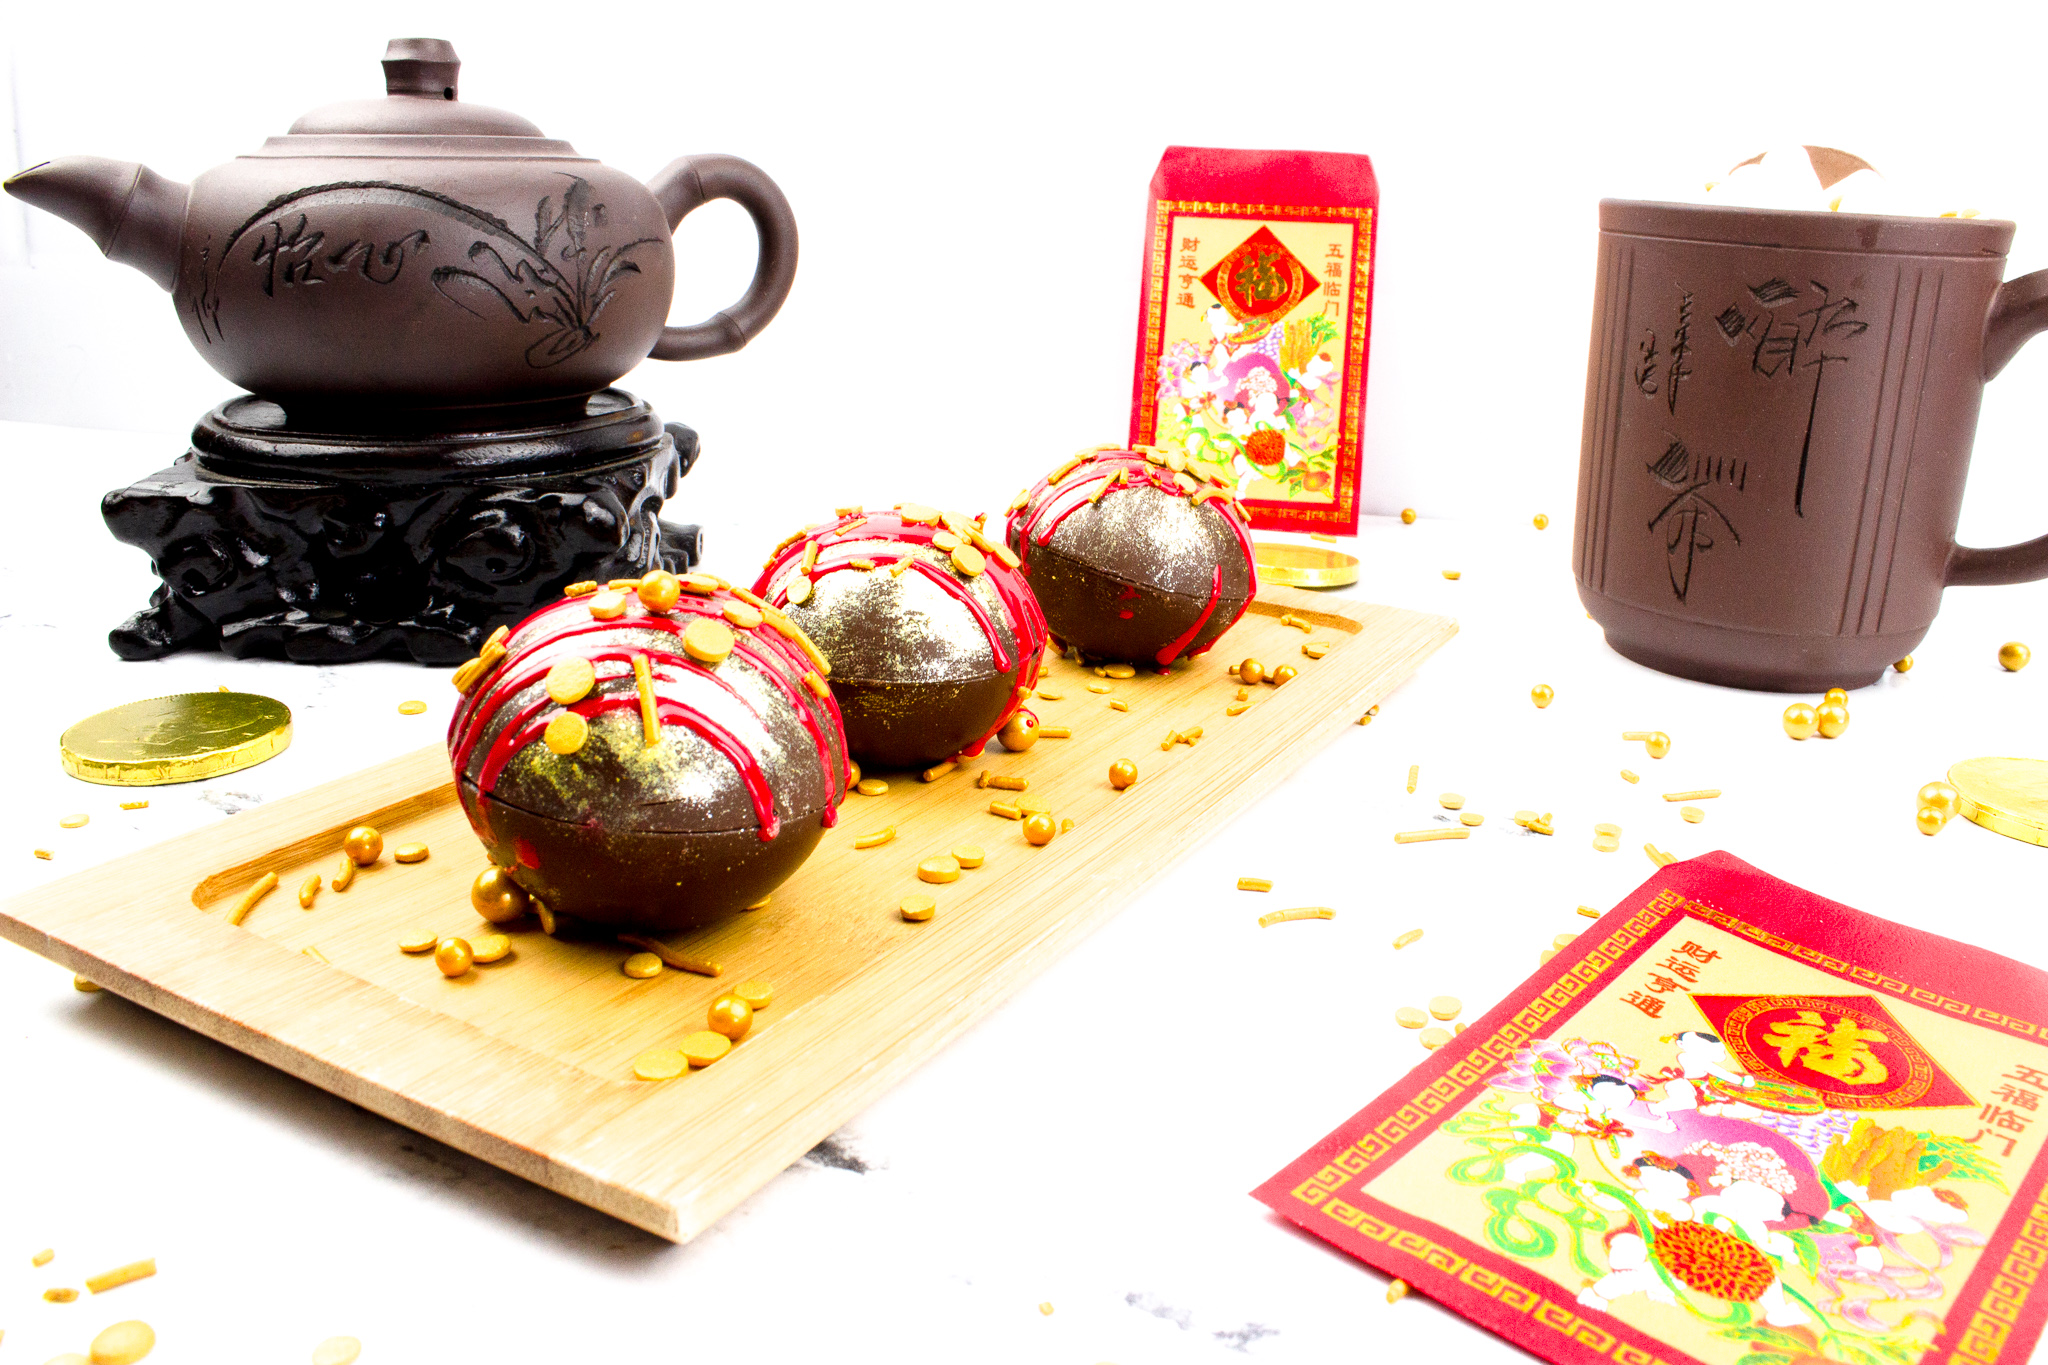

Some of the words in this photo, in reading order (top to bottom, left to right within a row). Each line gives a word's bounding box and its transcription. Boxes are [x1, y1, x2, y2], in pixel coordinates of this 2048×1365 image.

[1176, 237, 1200, 309] 财运亨通
[1235, 250, 1289, 307] 福
[1323, 243, 1345, 316] 五福临门
[1619, 939, 1723, 1020] 财运亨通
[1762, 1010, 1890, 1086] 福
[1964, 1063, 2048, 1158] 五福临门
